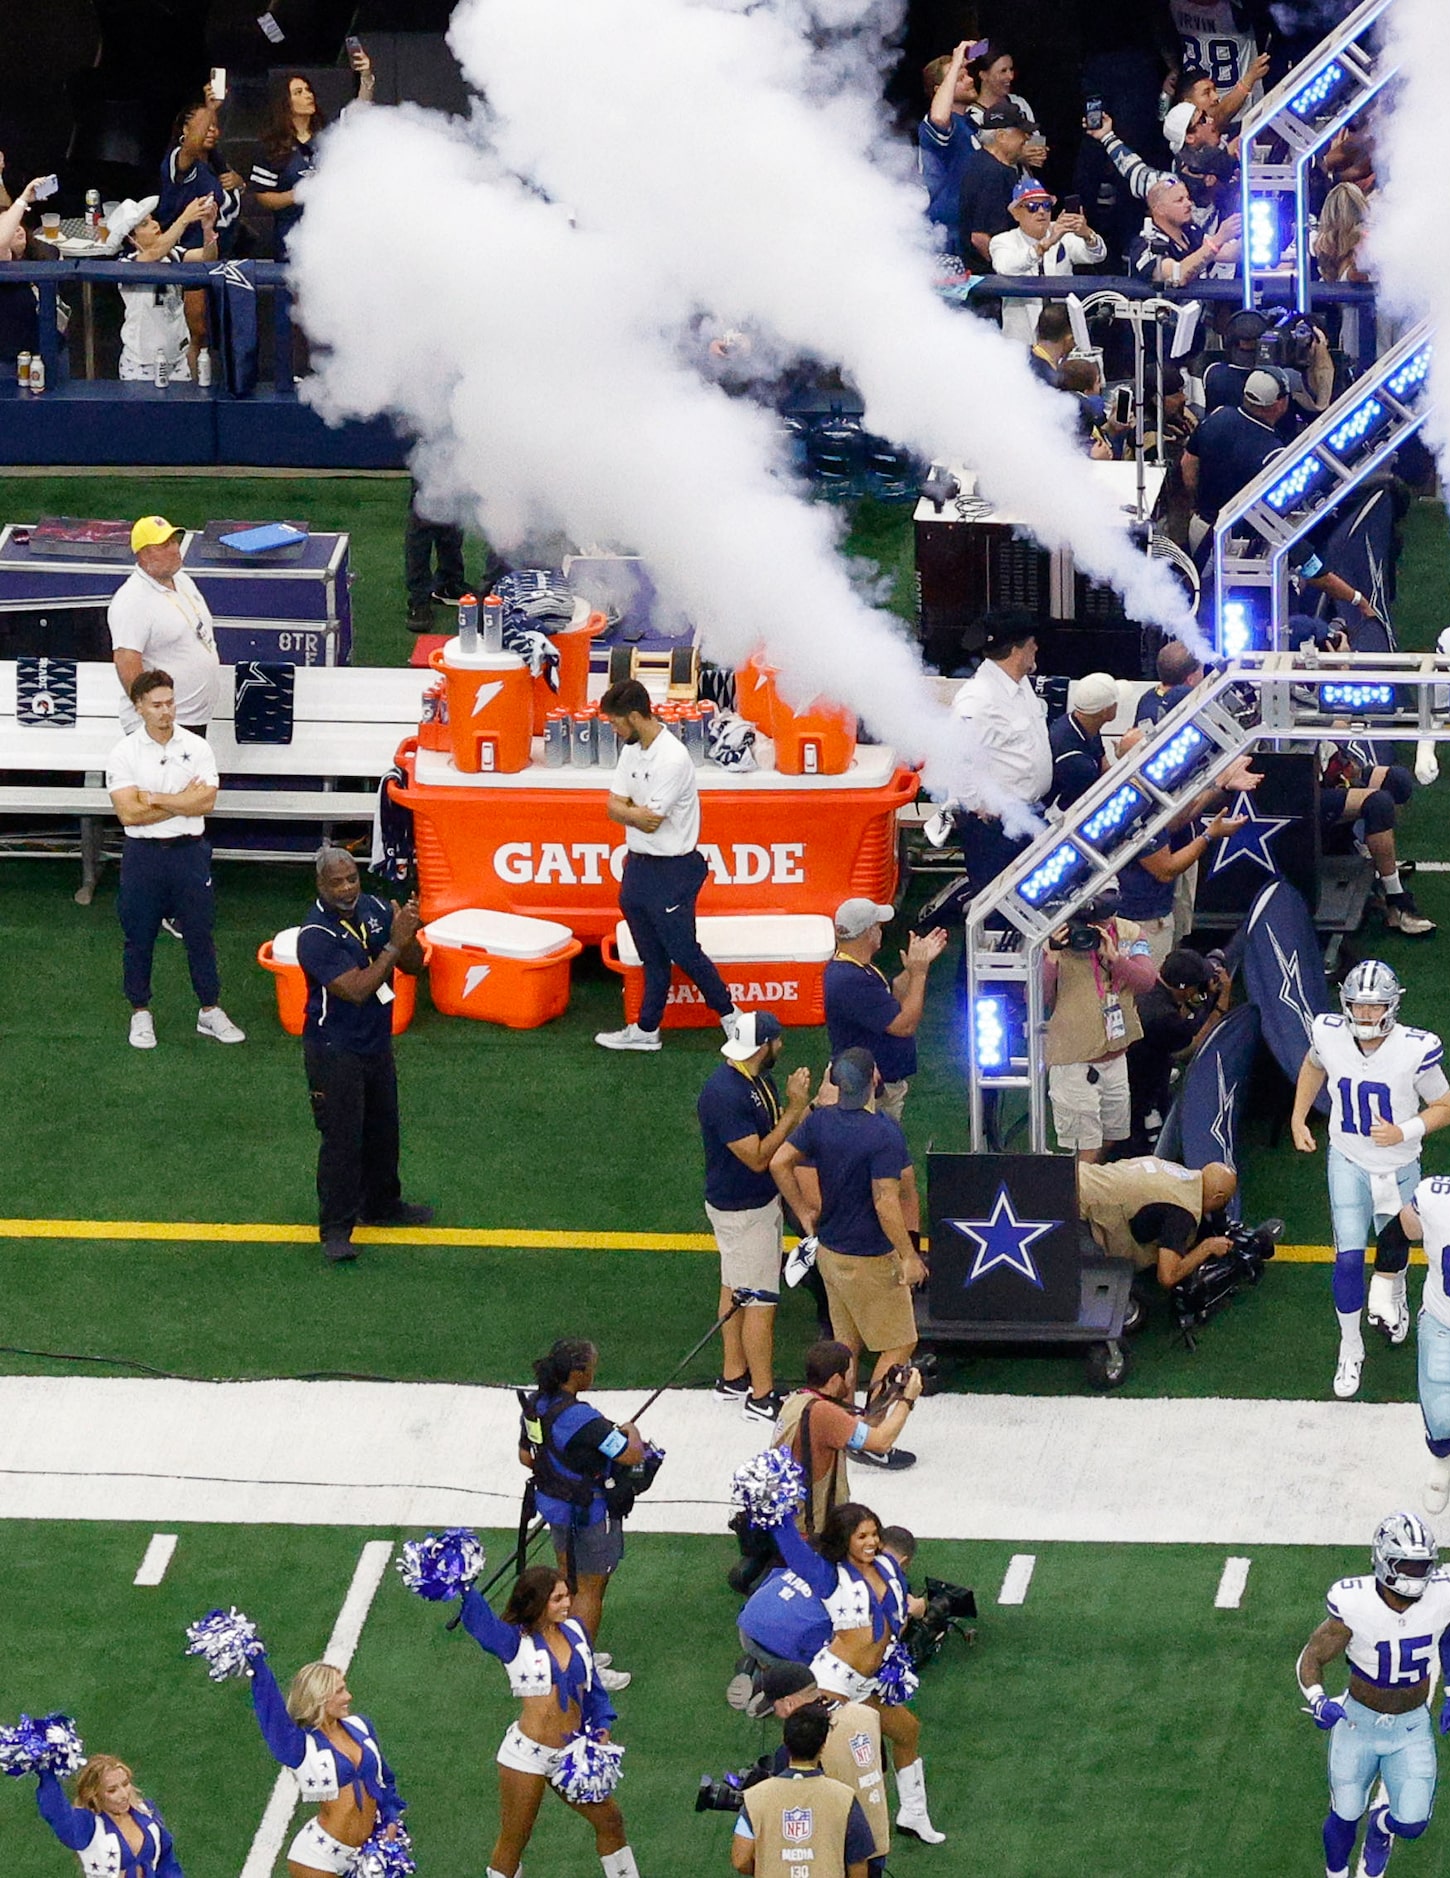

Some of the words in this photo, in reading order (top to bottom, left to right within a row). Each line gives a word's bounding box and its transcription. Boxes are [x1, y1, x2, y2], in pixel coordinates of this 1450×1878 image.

[279, 632, 319, 652] 8TR
[493, 842, 805, 885] GATADE
[666, 981, 800, 1004] ATRADE
[1338, 1076, 1394, 1137] 10
[1375, 1634, 1433, 1688] 15
[782, 1848, 814, 1861] MEDIA
